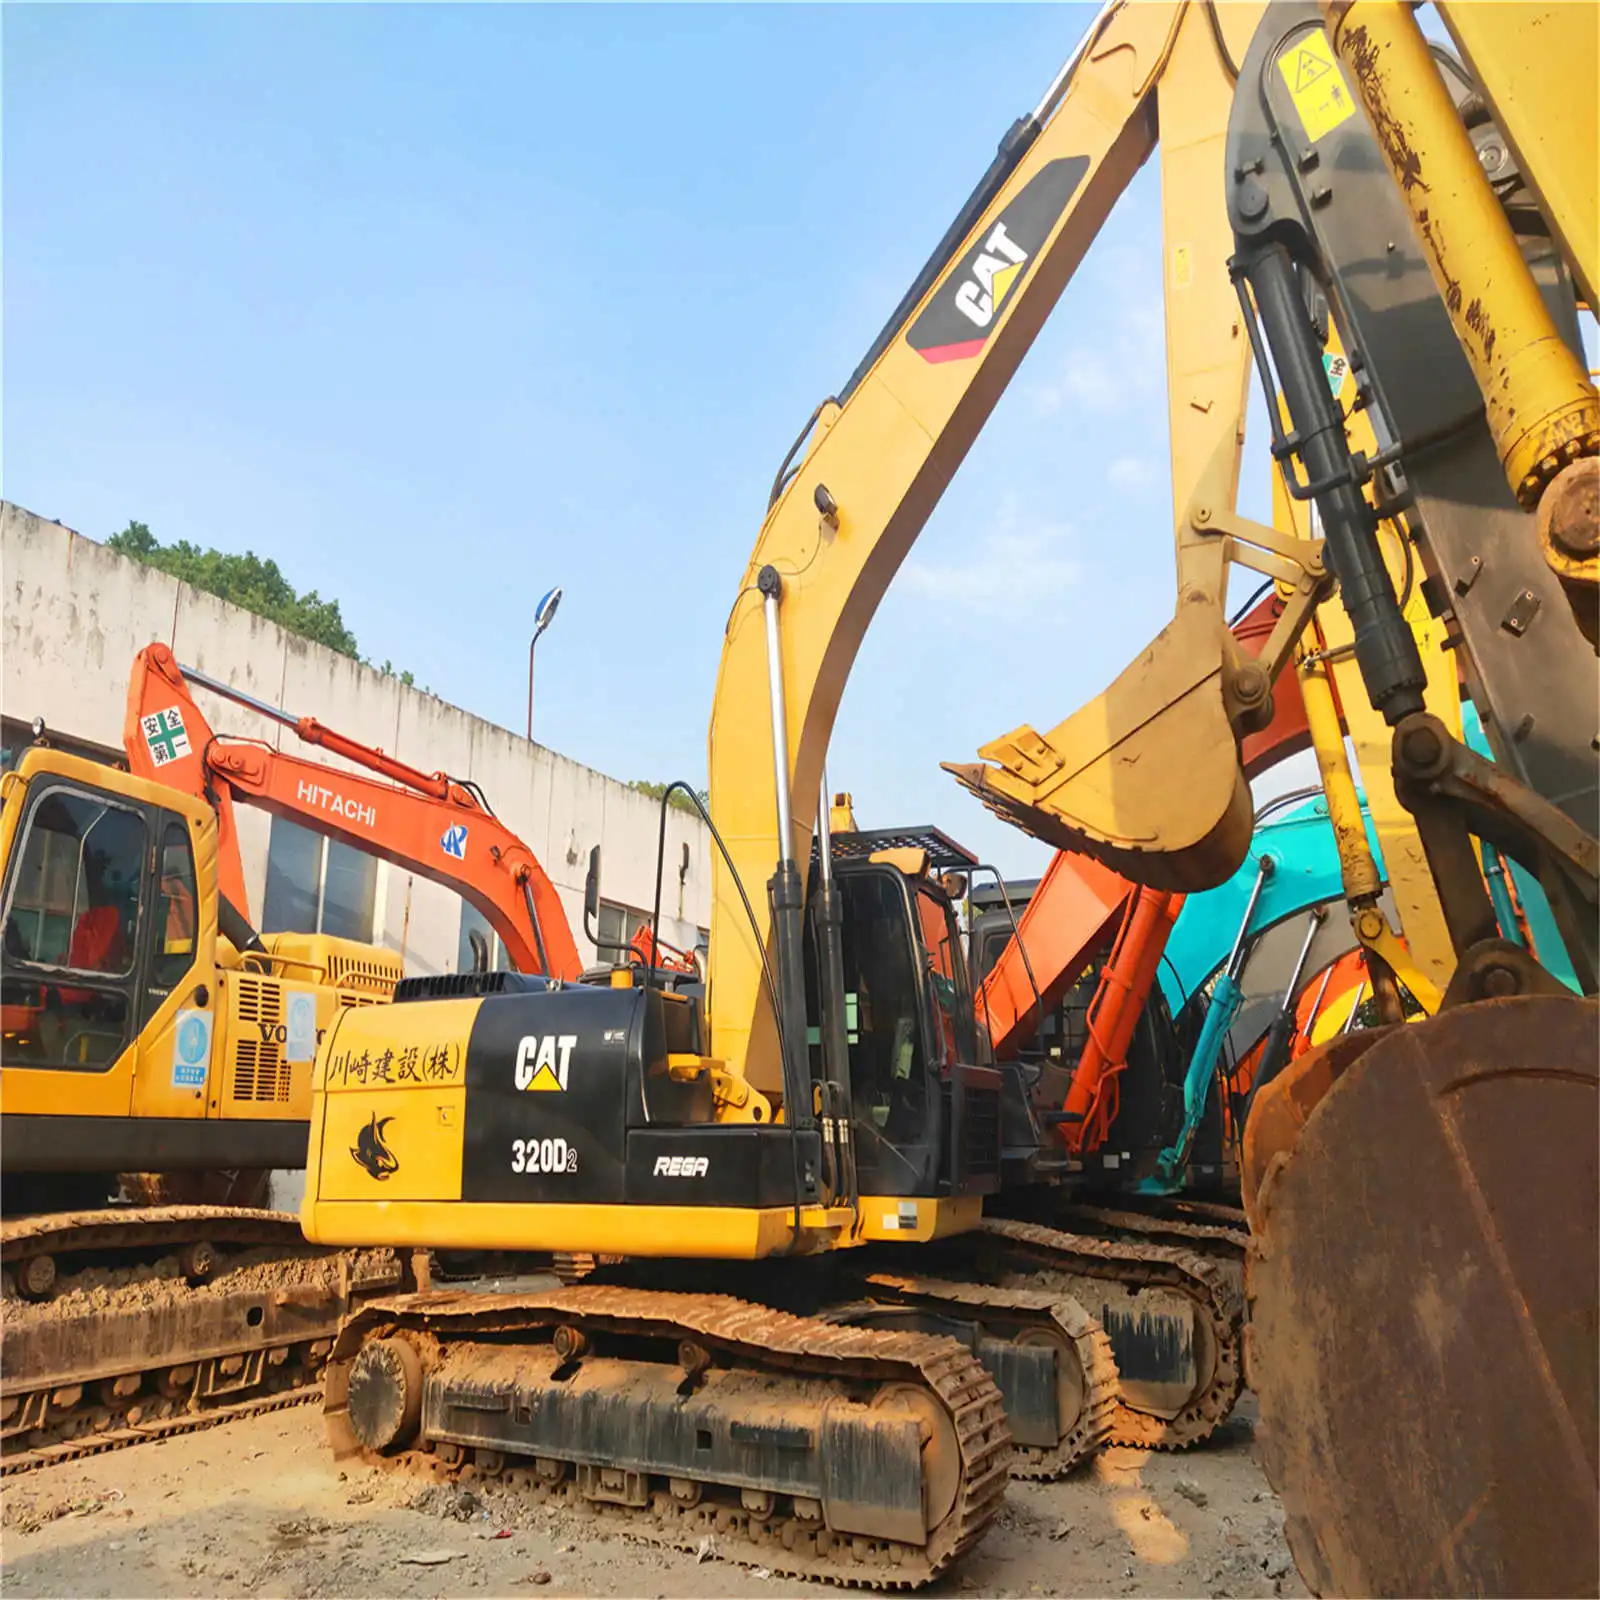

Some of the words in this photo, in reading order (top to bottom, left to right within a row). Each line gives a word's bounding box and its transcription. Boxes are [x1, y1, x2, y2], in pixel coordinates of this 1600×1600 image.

[955, 221, 1028, 327] CAT
[297, 779, 376, 827] HITACHI
[514, 1035, 577, 1091] CAT
[653, 1156, 709, 1177] REGA
